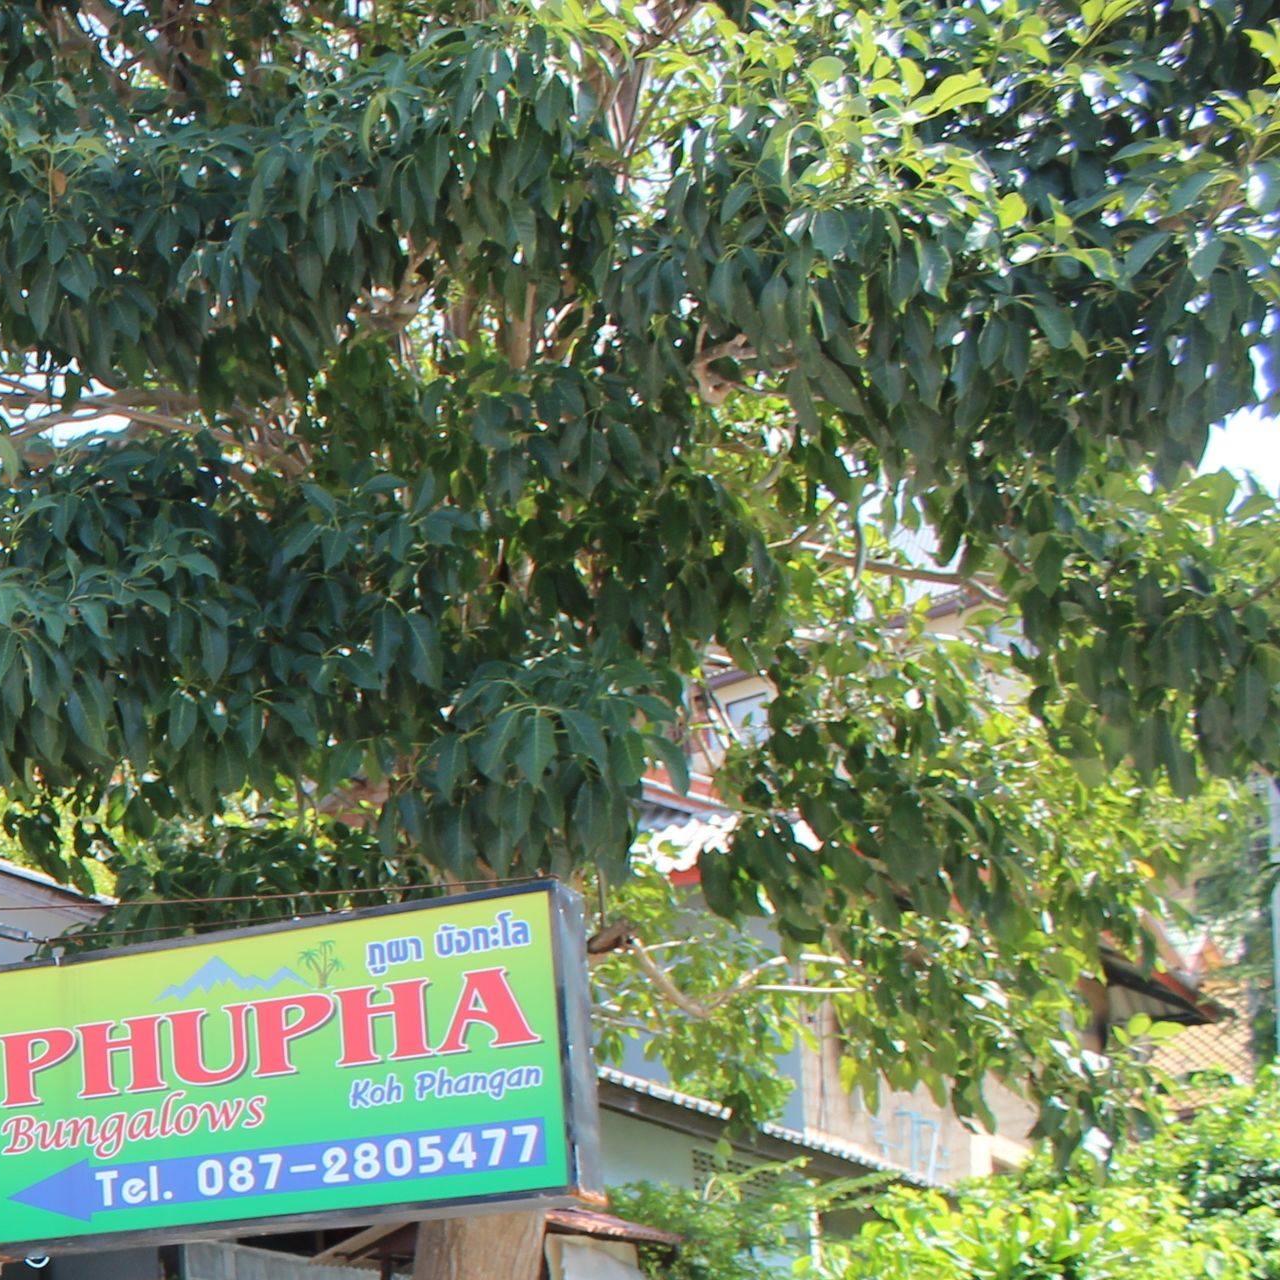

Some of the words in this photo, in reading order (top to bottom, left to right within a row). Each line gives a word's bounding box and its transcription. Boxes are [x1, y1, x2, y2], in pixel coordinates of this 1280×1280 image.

[367, 937, 423, 976] ภูผา
[434, 911, 531, 956] บังกะโล
[351, 1073, 403, 1109] Koh
[416, 1066, 542, 1101] Phangan
[1, 1090, 267, 1158] Bungalows
[95, 1164, 173, 1206] Tel.
[196, 1124, 539, 1196] 087-2805477
